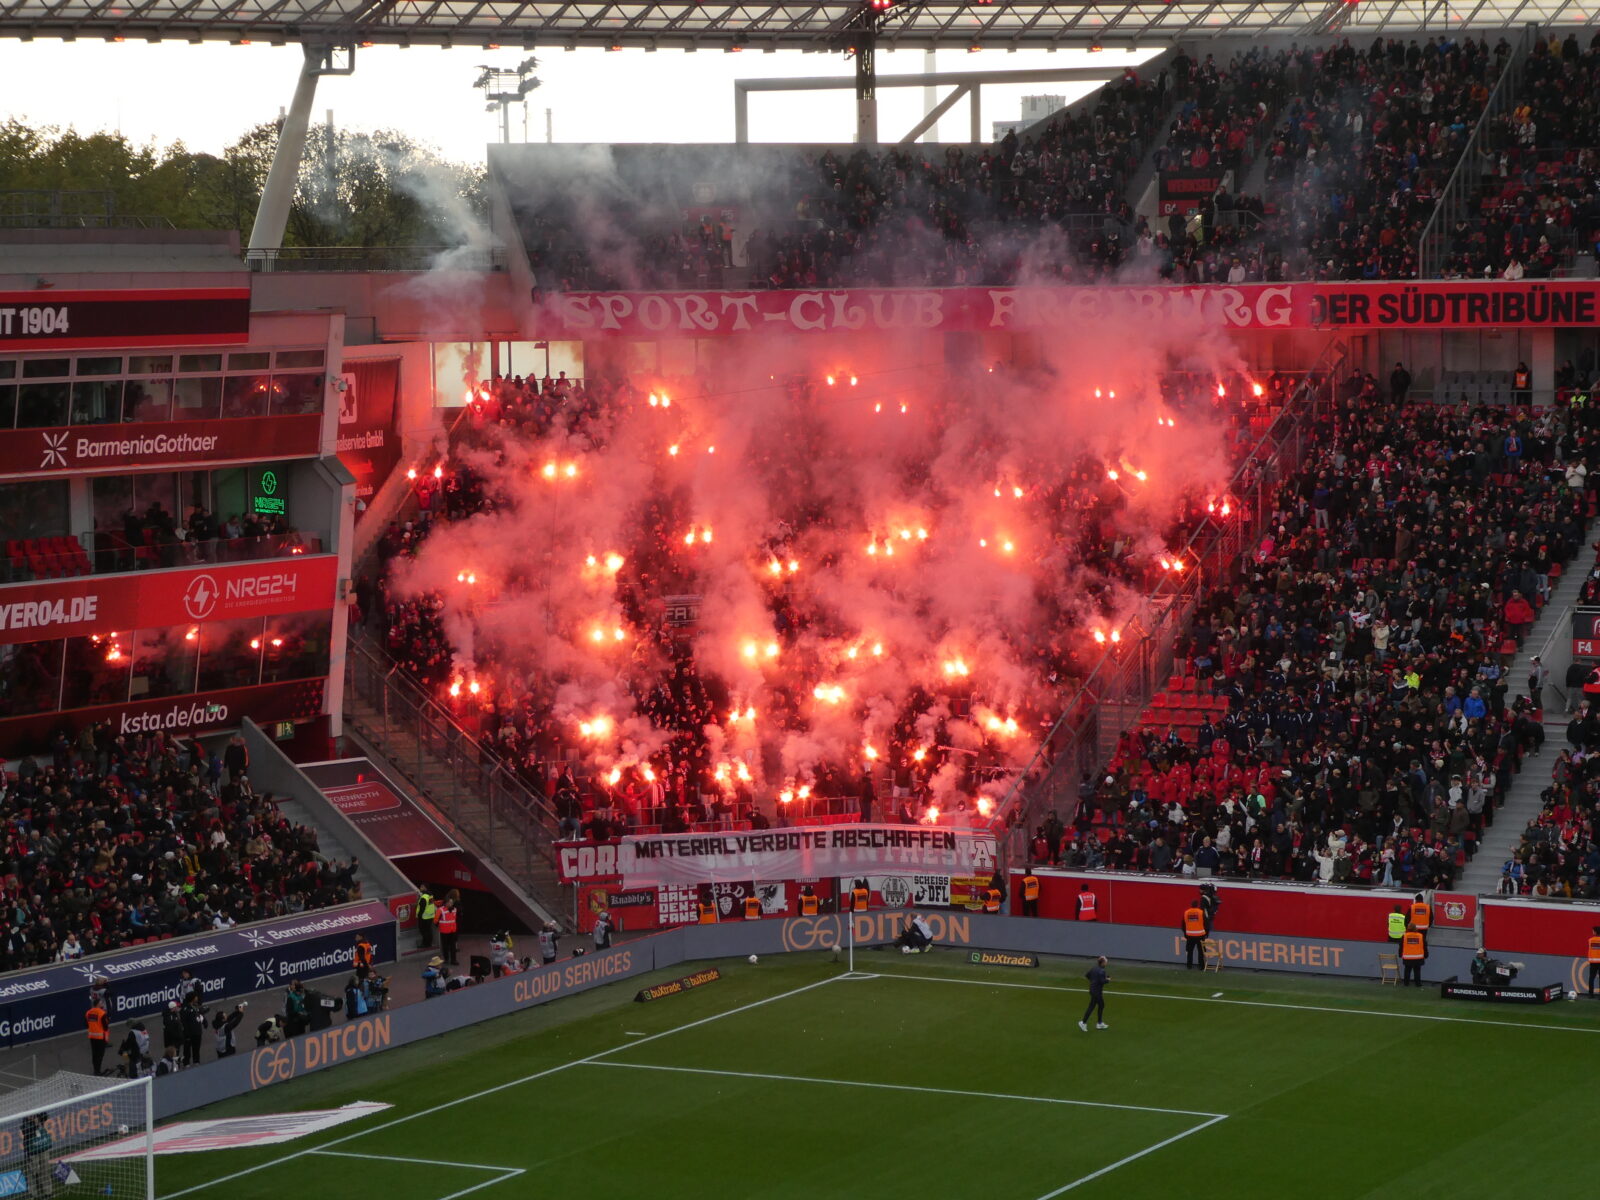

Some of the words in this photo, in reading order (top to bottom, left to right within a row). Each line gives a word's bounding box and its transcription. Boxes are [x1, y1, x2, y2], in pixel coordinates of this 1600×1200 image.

[562, 293, 944, 331] SPORT-CLUB
[1311, 293, 1370, 325] DER
[1378, 285, 1595, 324] SÜDTRIBÜNE
[20, 307, 69, 334] 1904
[76, 433, 218, 458] BarmeniaGothaer
[226, 573, 297, 600] NRG24
[1578, 641, 1593, 654] F4
[120, 701, 228, 735] ksta.de/abo
[831, 828, 956, 850] ABSCHAFFEN
[913, 876, 949, 886] SCHEISS
[928, 885, 950, 903] DFL
[659, 891, 698, 902] BALL
[659, 901, 689, 913] DEN
[268, 911, 372, 941] BarmeniaGothaer
[659, 912, 699, 924] FANS
[854, 912, 970, 944] DITON
[104, 943, 219, 975] BarmeniaGothaer
[279, 943, 378, 977] BarmeniaGothr
[981, 952, 1032, 966] buXtrade
[514, 973, 561, 1003] CLOUD
[565, 951, 632, 988] SERVICES
[650, 981, 682, 999] buXtrade
[689, 968, 720, 987] buXtrade
[1453, 988, 1488, 997] BUNDESLIGA
[1501, 991, 1537, 999] BUNDESLIGA
[305, 1014, 391, 1070] DITCON
